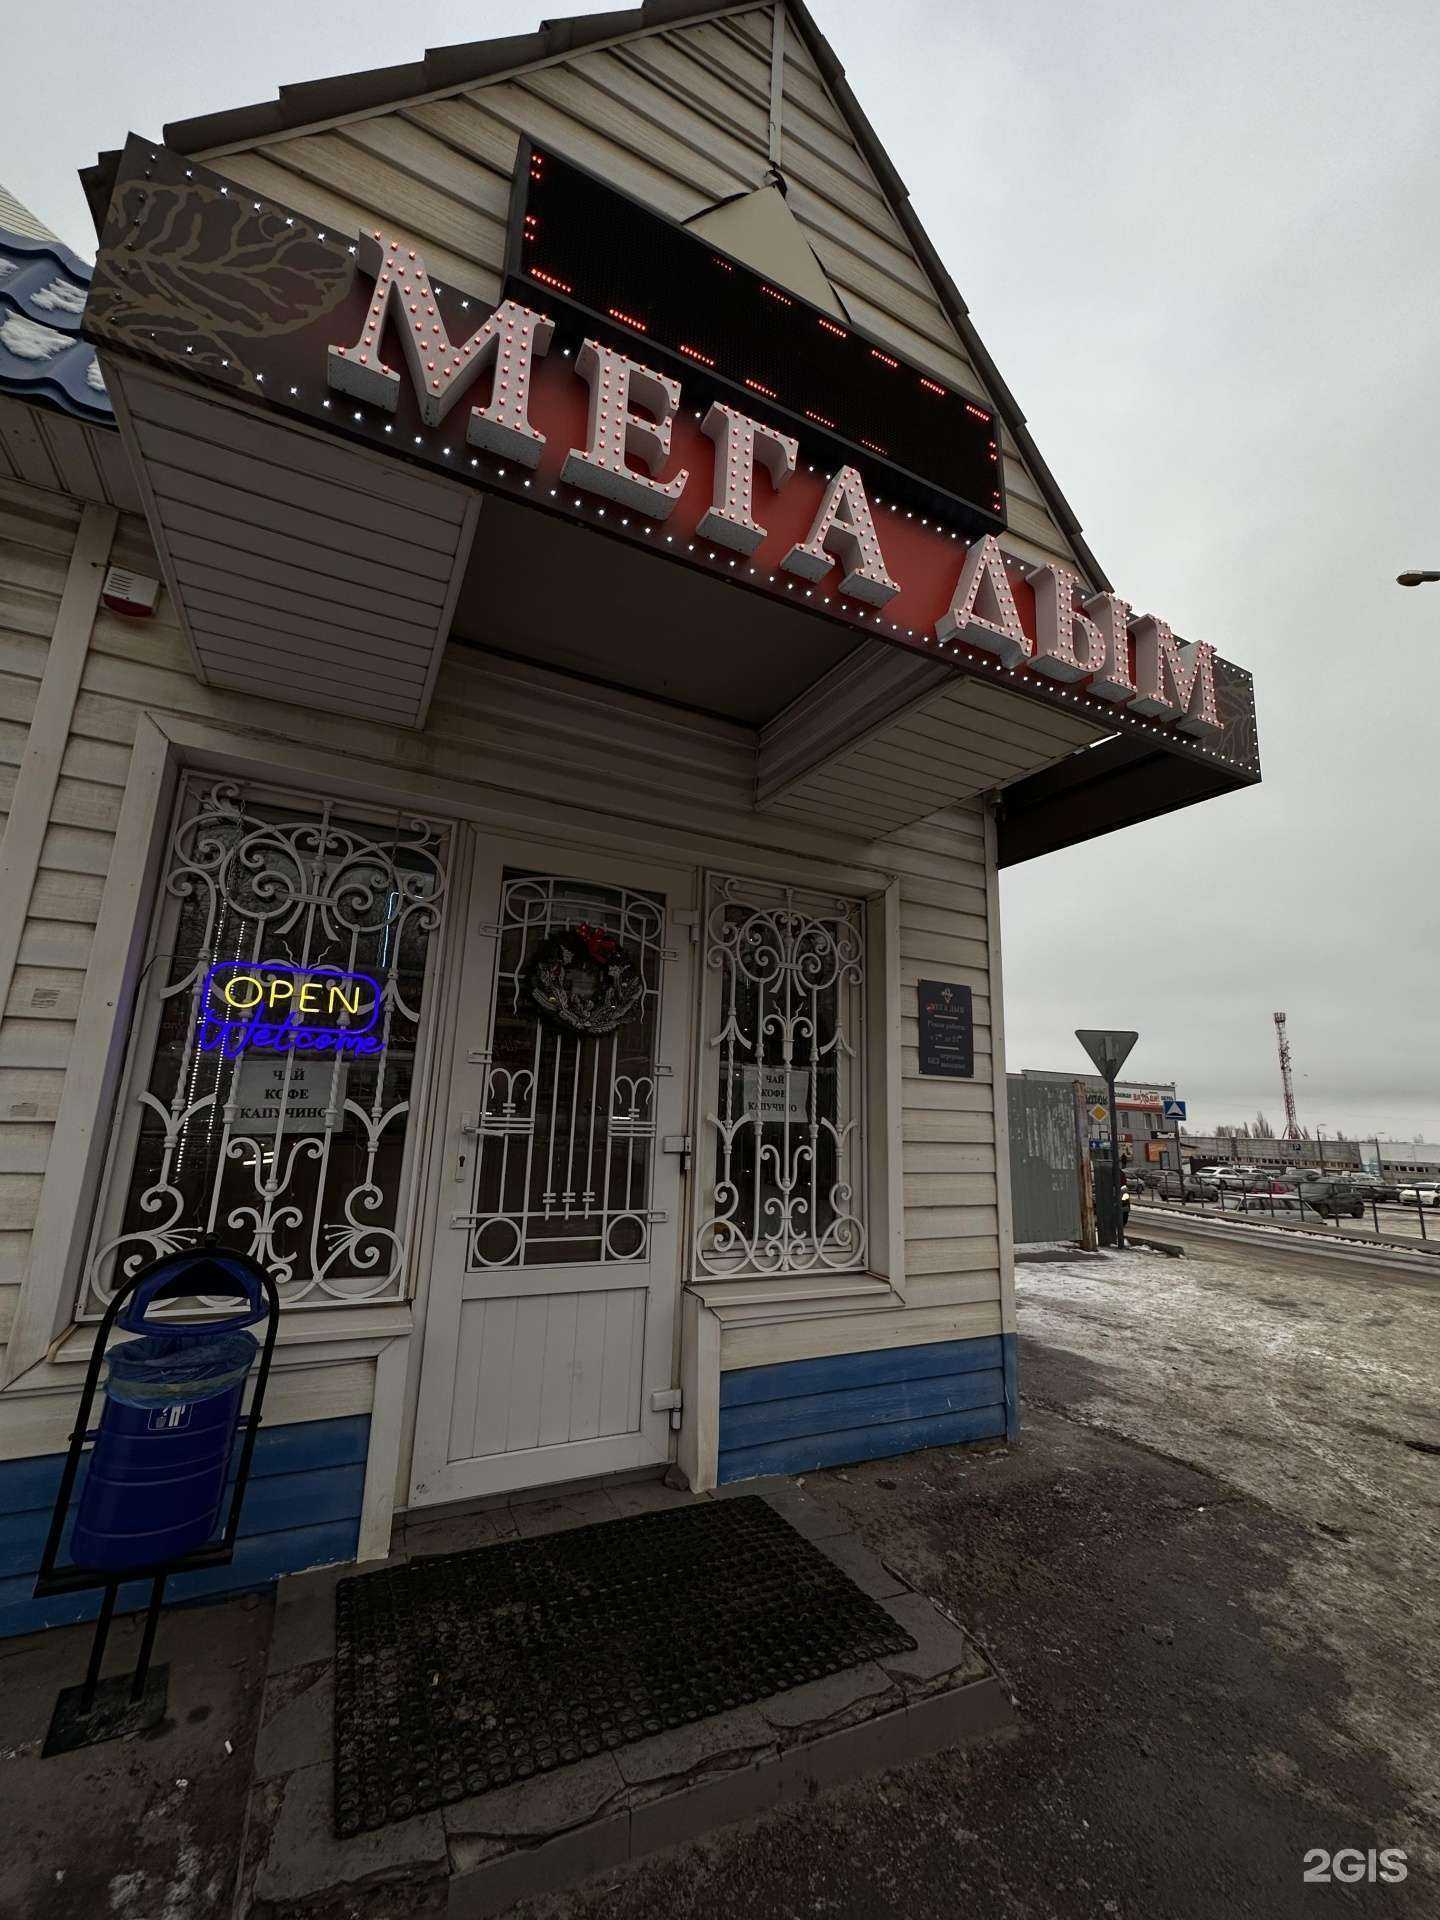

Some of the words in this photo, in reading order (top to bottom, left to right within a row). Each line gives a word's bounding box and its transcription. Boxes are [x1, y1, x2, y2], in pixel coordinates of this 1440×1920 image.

[327, 228, 902, 606] МЕГА
[935, 534, 1225, 732] ДЫМ
[224, 975, 361, 1015] OPEN
[199, 1002, 386, 1060] Welcome
[264, 1088, 310, 1100] КОФЕ
[766, 1074, 785, 1084] ЧАЙ
